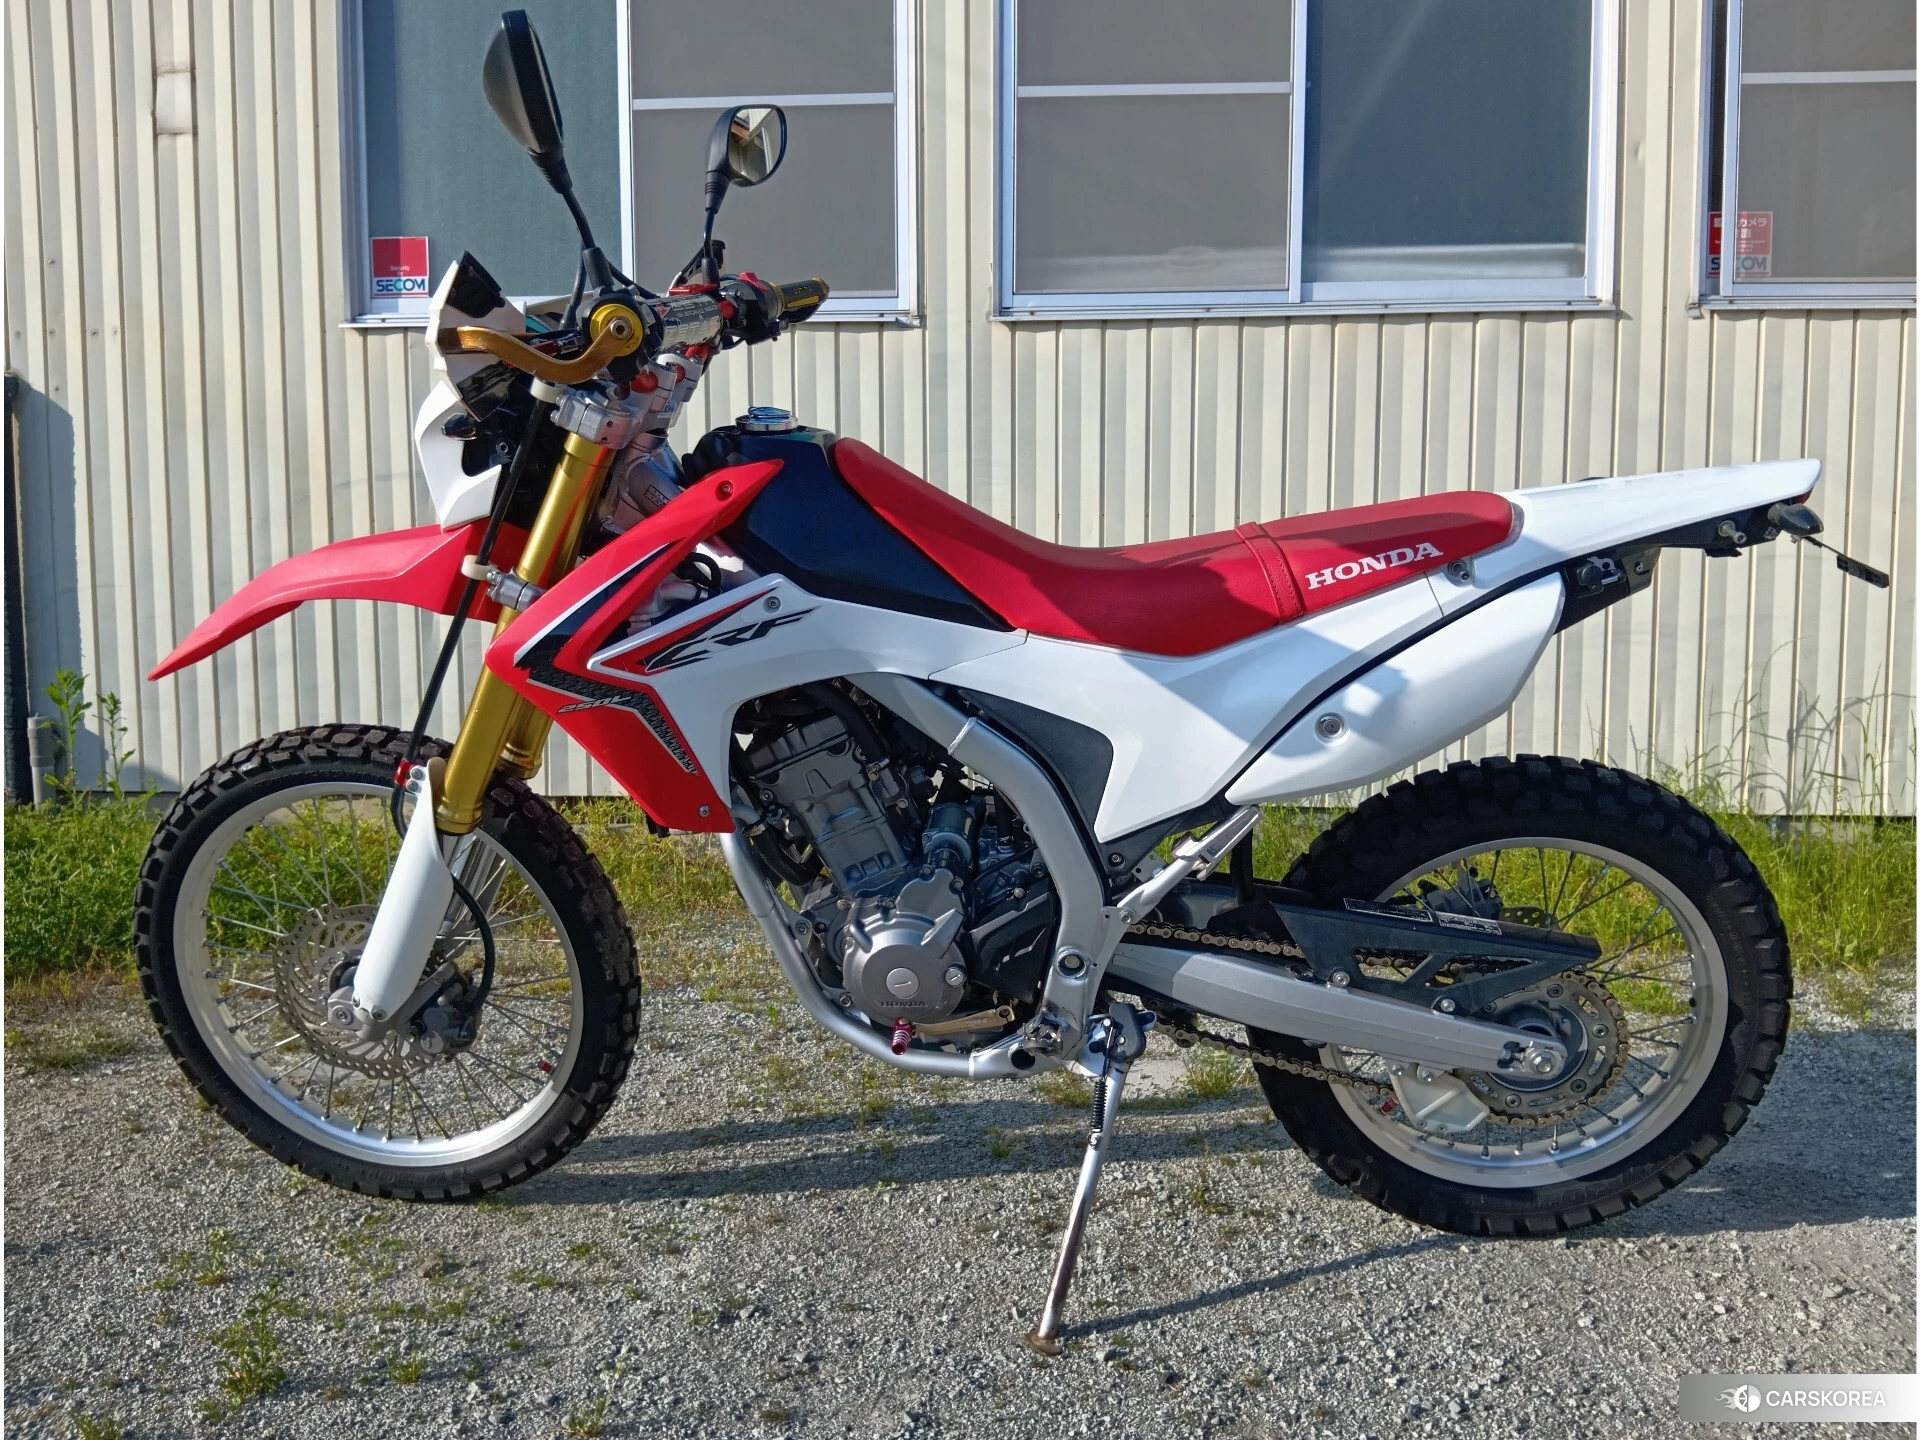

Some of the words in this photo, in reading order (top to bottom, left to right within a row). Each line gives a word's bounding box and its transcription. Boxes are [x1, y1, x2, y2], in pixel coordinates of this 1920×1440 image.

[1713, 217, 1767, 228] カメラ
[1711, 256, 1767, 271] SOM
[376, 278, 426, 292] SECOM
[1305, 542, 1444, 590] HONDA
[645, 605, 824, 672] CRF
[557, 695, 632, 714] 250L
[880, 1000, 929, 1008] HONDA
